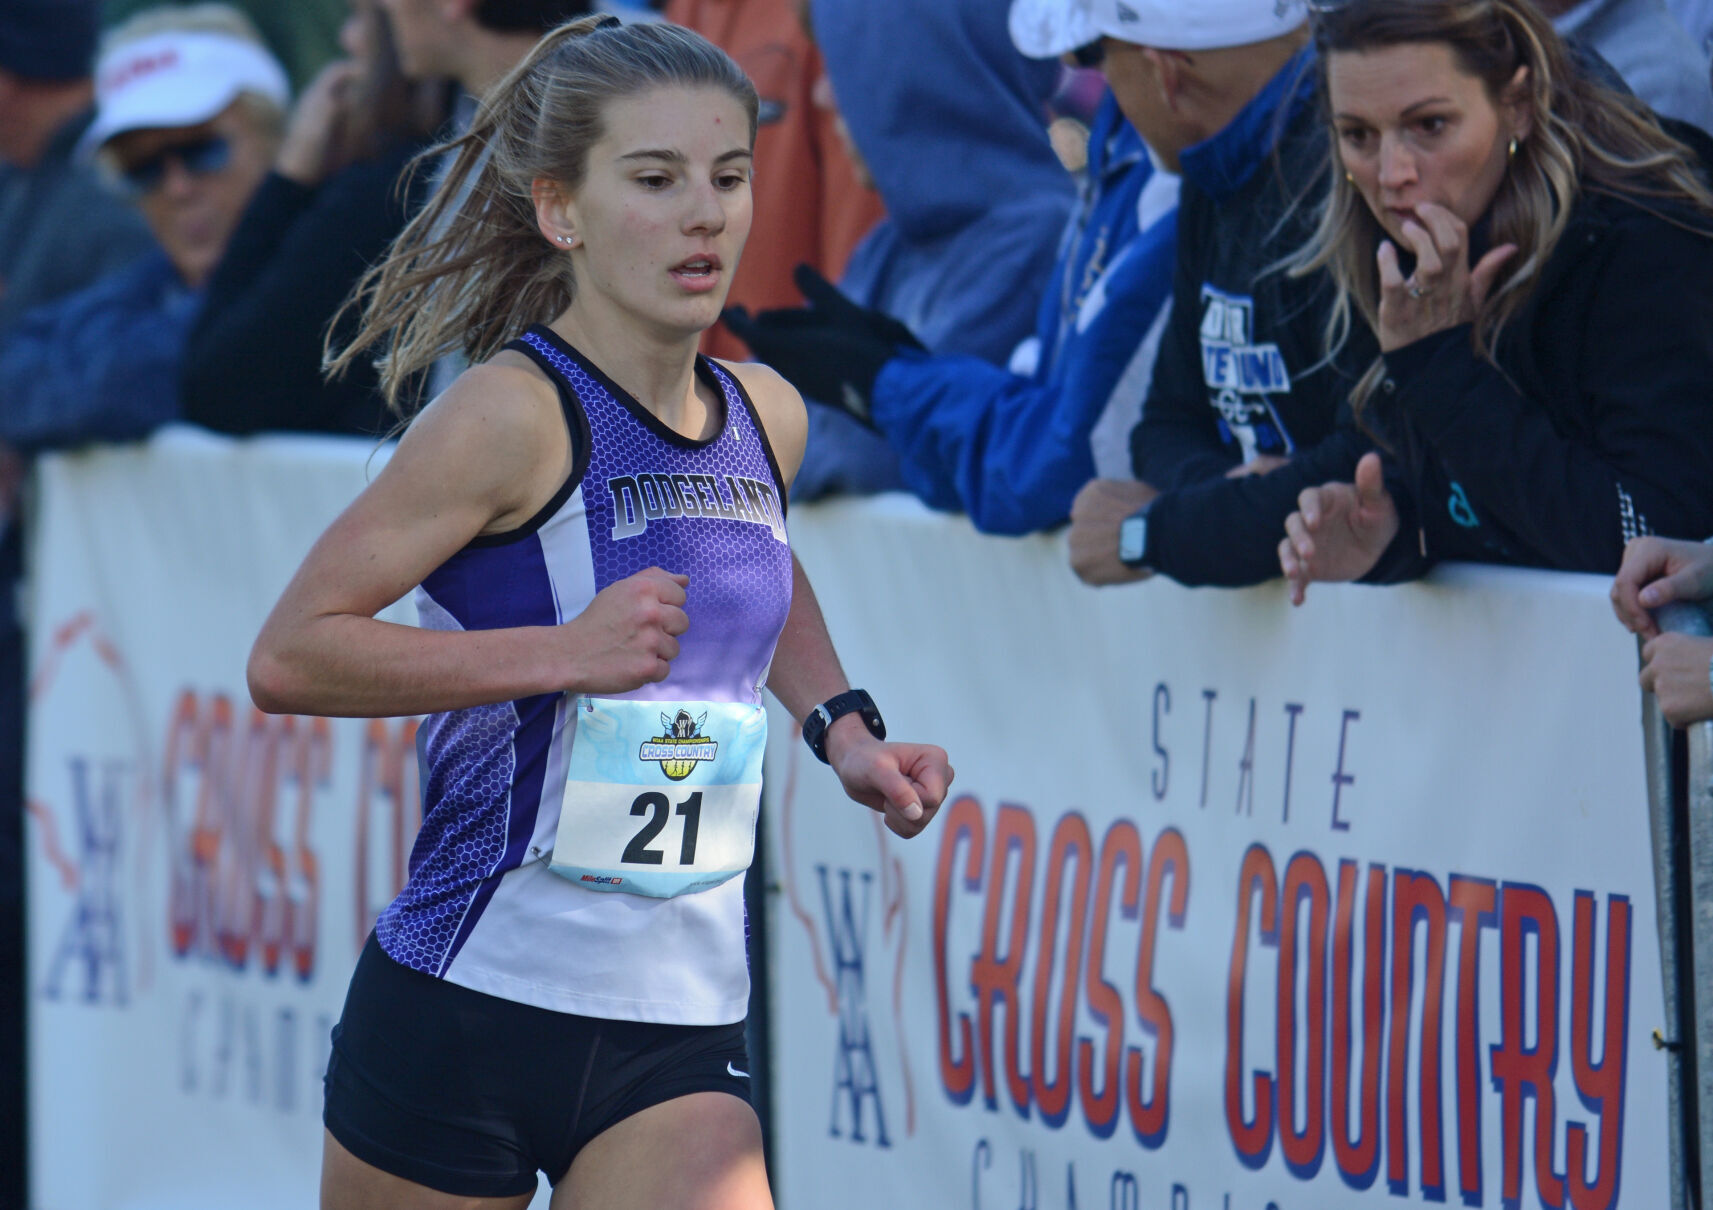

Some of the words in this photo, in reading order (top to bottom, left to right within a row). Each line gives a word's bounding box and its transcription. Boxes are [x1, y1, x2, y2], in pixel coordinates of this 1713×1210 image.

[608, 472, 788, 542] DODGELAND
[641, 744, 674, 758] CROSS
[675, 744, 715, 758] COUNTRY
[1152, 682, 1361, 832] STATE
[621, 791, 703, 865] 21
[933, 793, 1190, 1151] CROSS
[1224, 842, 1633, 1210] COUNTRY
